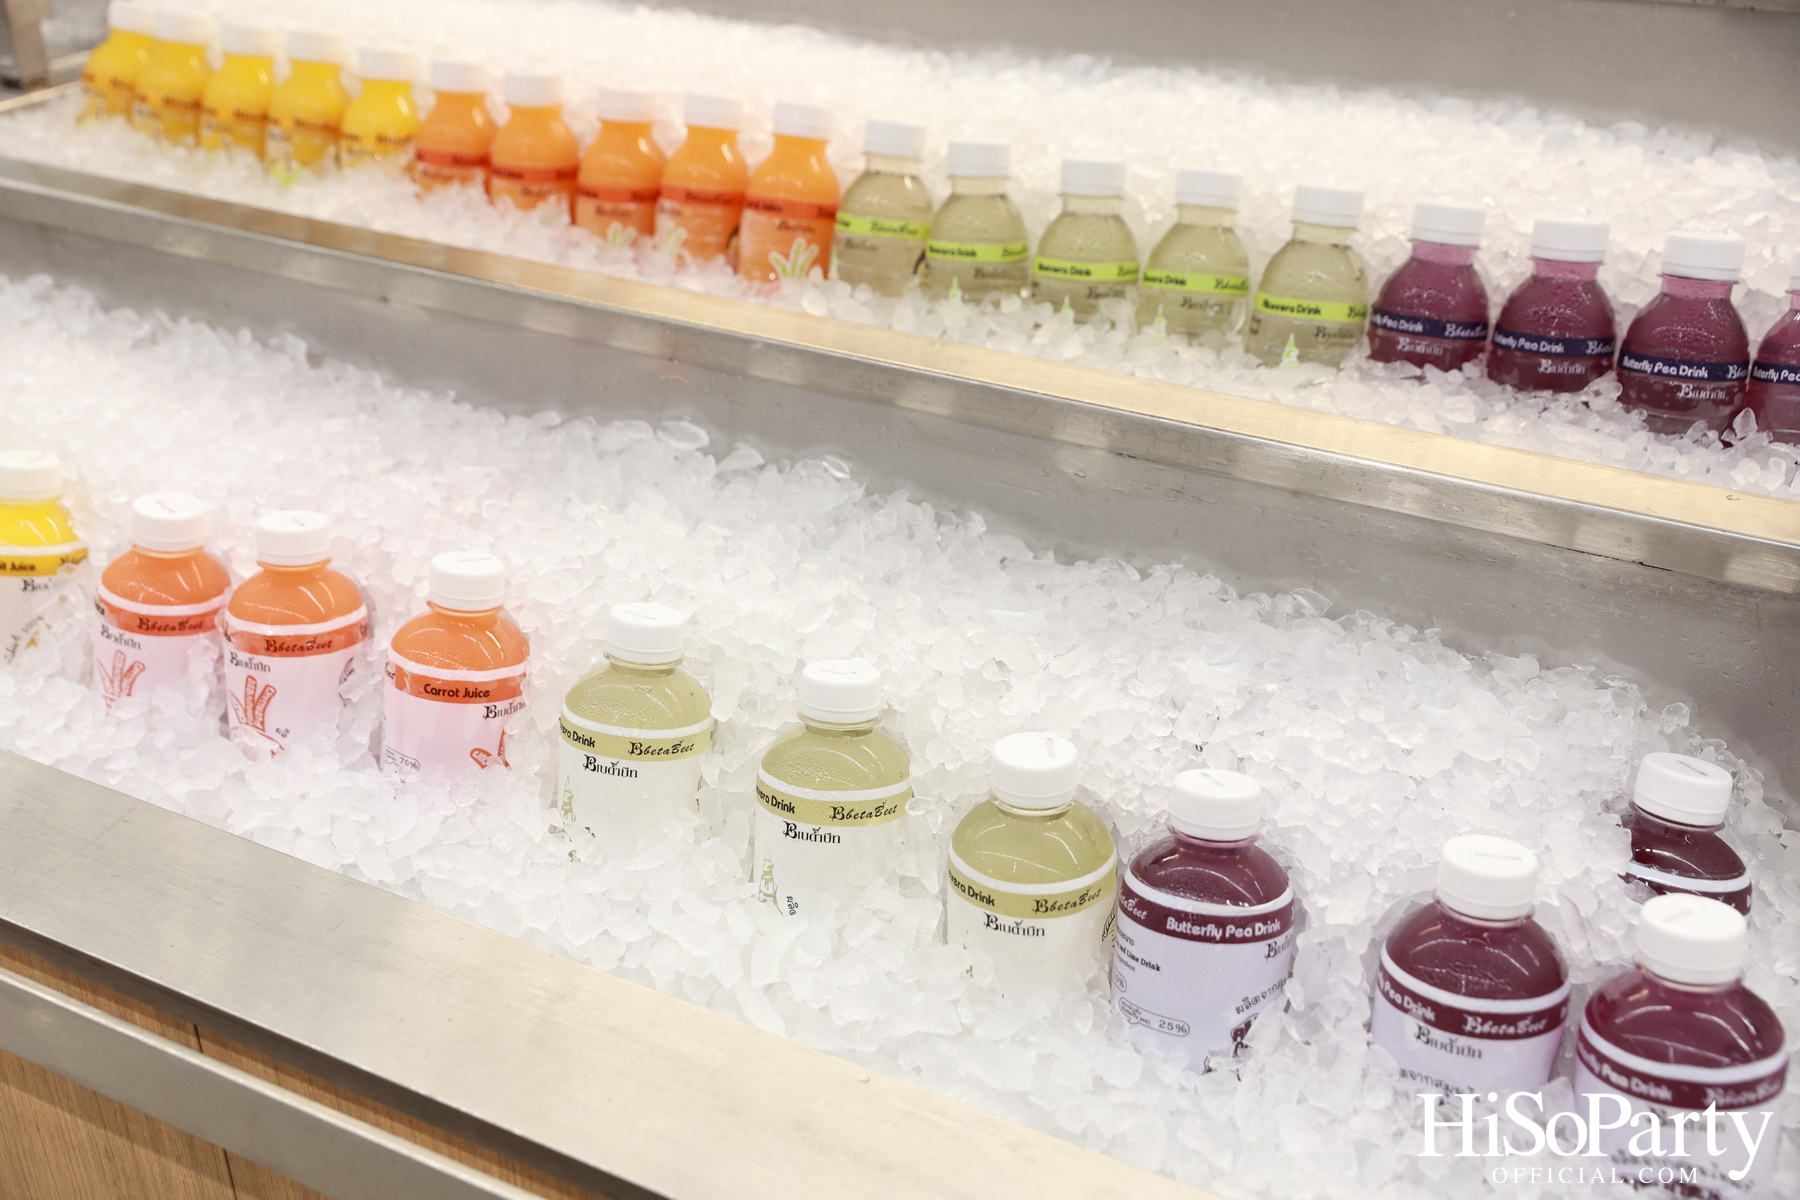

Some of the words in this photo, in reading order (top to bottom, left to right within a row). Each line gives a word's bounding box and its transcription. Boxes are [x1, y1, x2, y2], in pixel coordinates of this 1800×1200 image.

[1296, 304, 1321, 315] Drink
[1399, 319, 1424, 332] Drink
[1518, 337, 1538, 351] Pea
[1539, 341, 1564, 354] Drink
[1653, 361, 1677, 375] Pea
[1679, 365, 1708, 379] Drink
[10, 560, 37, 572] Juice
[424, 683, 460, 698] Carrot
[462, 687, 490, 699] Juice
[572, 730, 596, 748] Drink
[770, 795, 796, 815] Drink
[967, 885, 995, 907] Drink
[1166, 916, 1223, 941] Butterfly
[1225, 924, 1253, 939] Pea
[1254, 918, 1281, 937] Drink
[1140, 959, 1161, 972] Drink
[1384, 980, 1403, 1005] Pea
[1403, 994, 1435, 1022] Drink
[1158, 1019, 1188, 1034] 25%
